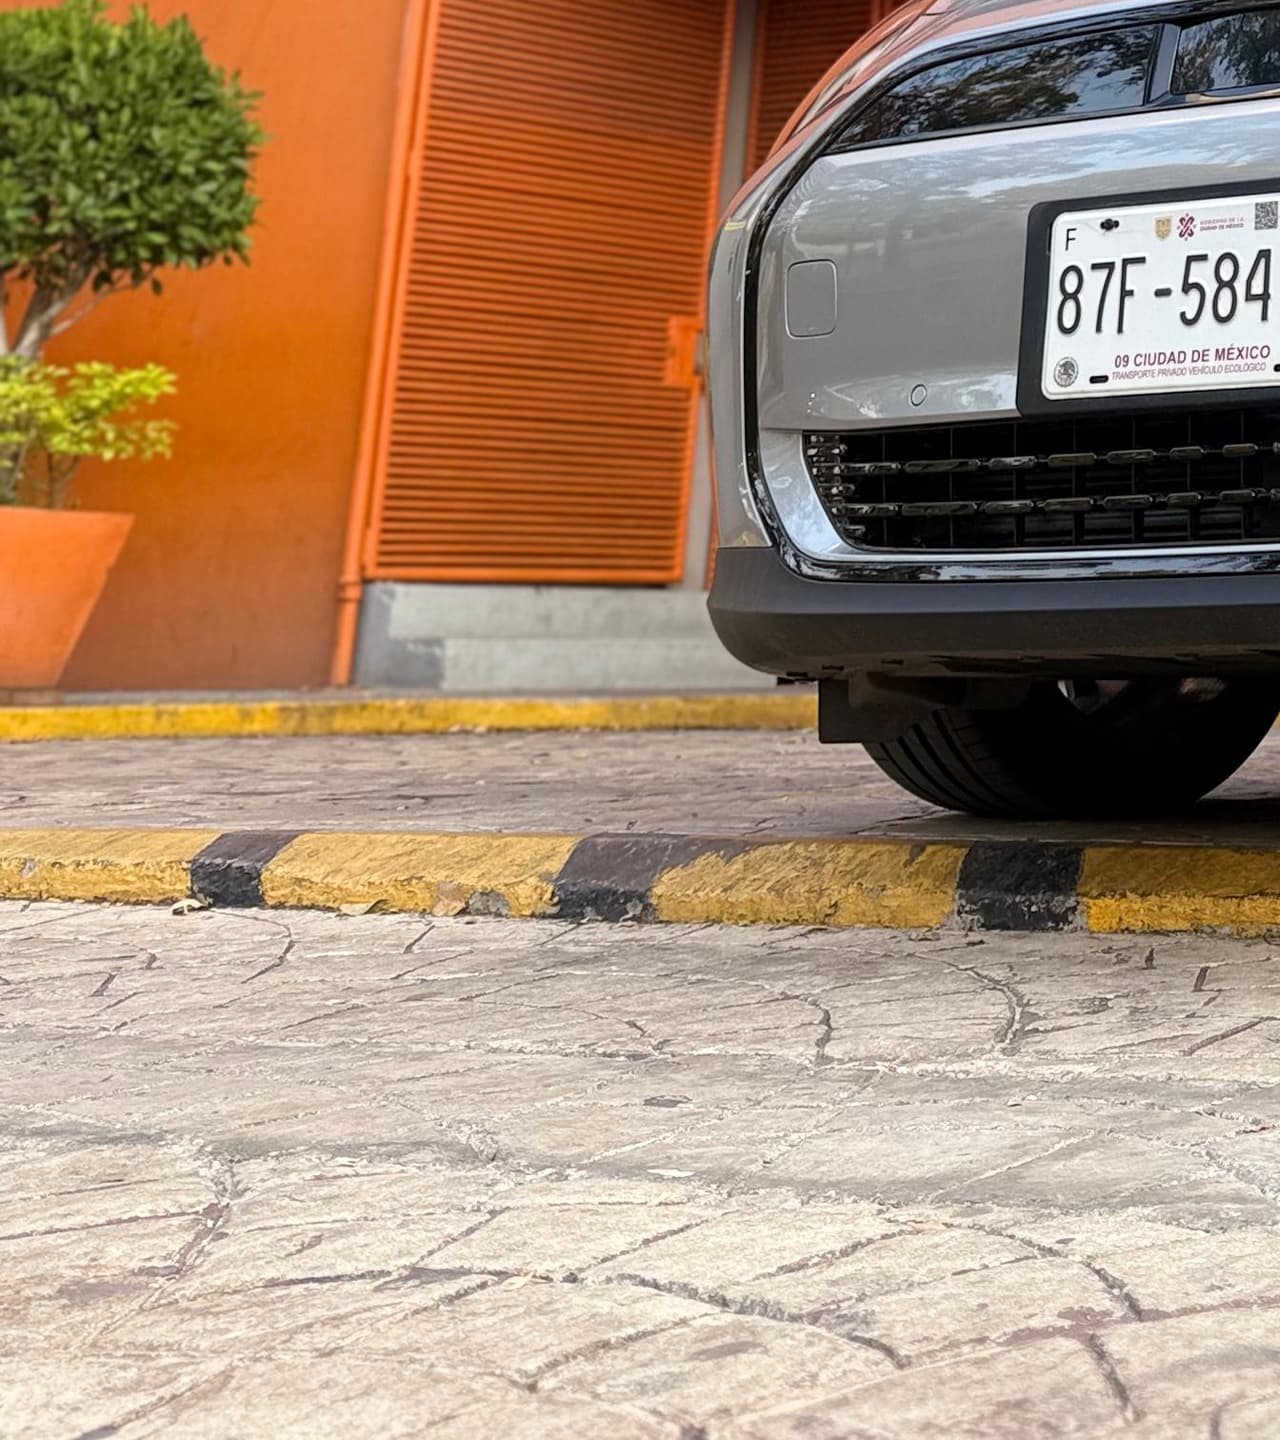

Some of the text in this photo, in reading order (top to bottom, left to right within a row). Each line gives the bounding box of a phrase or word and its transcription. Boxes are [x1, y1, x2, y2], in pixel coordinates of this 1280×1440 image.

[1065, 228, 1077, 251] F
[1057, 248, 1273, 335] 87F-584
[1114, 344, 1271, 368] 09 CIUDAD DE MÉXICO
[1111, 368, 1156, 381] TRANSPORTE
[1157, 366, 1188, 378] PRIVADO
